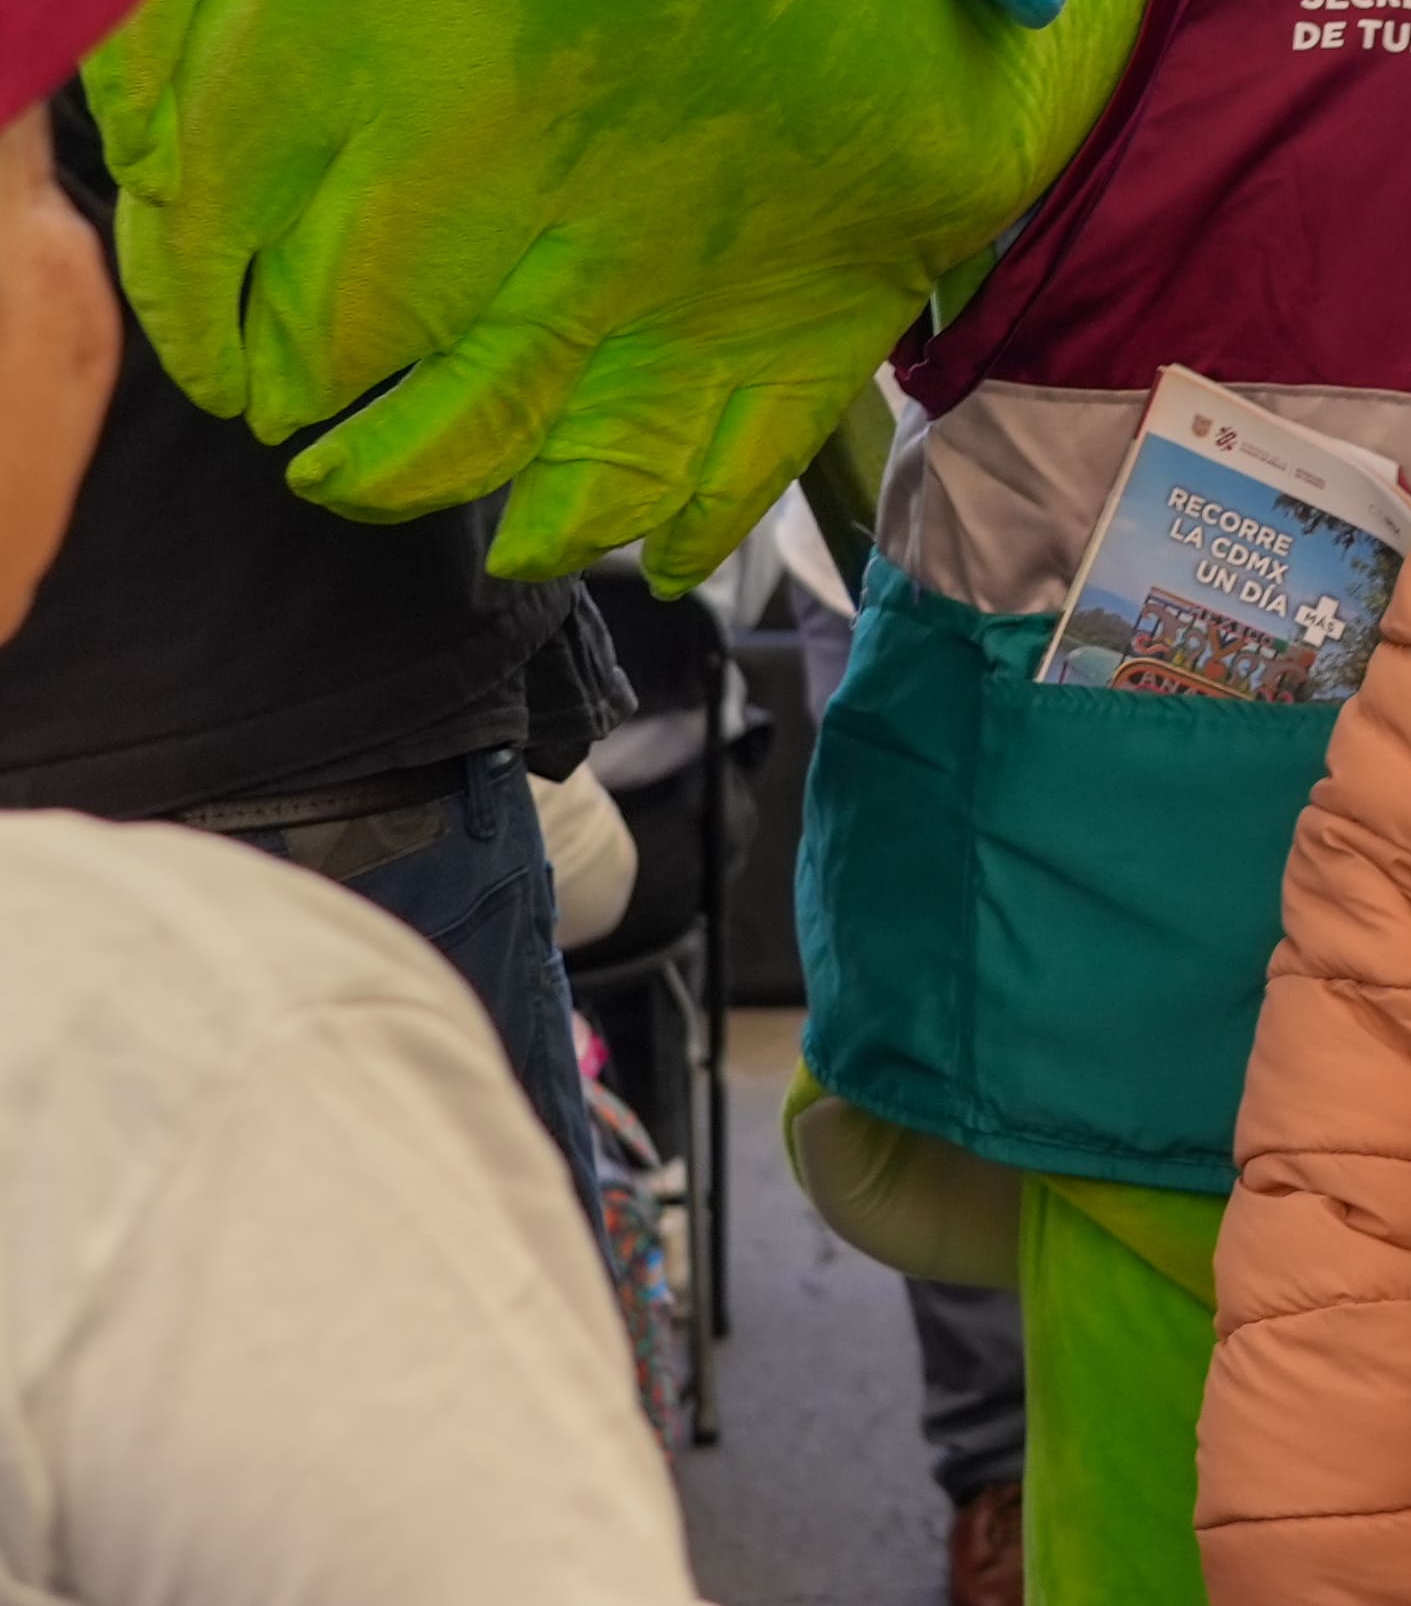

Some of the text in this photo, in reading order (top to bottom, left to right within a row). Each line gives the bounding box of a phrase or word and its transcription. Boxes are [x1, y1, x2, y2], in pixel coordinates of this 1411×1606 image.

[1291, 20, 1347, 51] DE
[1167, 486, 1295, 557] RECORRE
[1169, 516, 1290, 585] LA CDMX
[1195, 558, 1289, 618] UN DÍA
